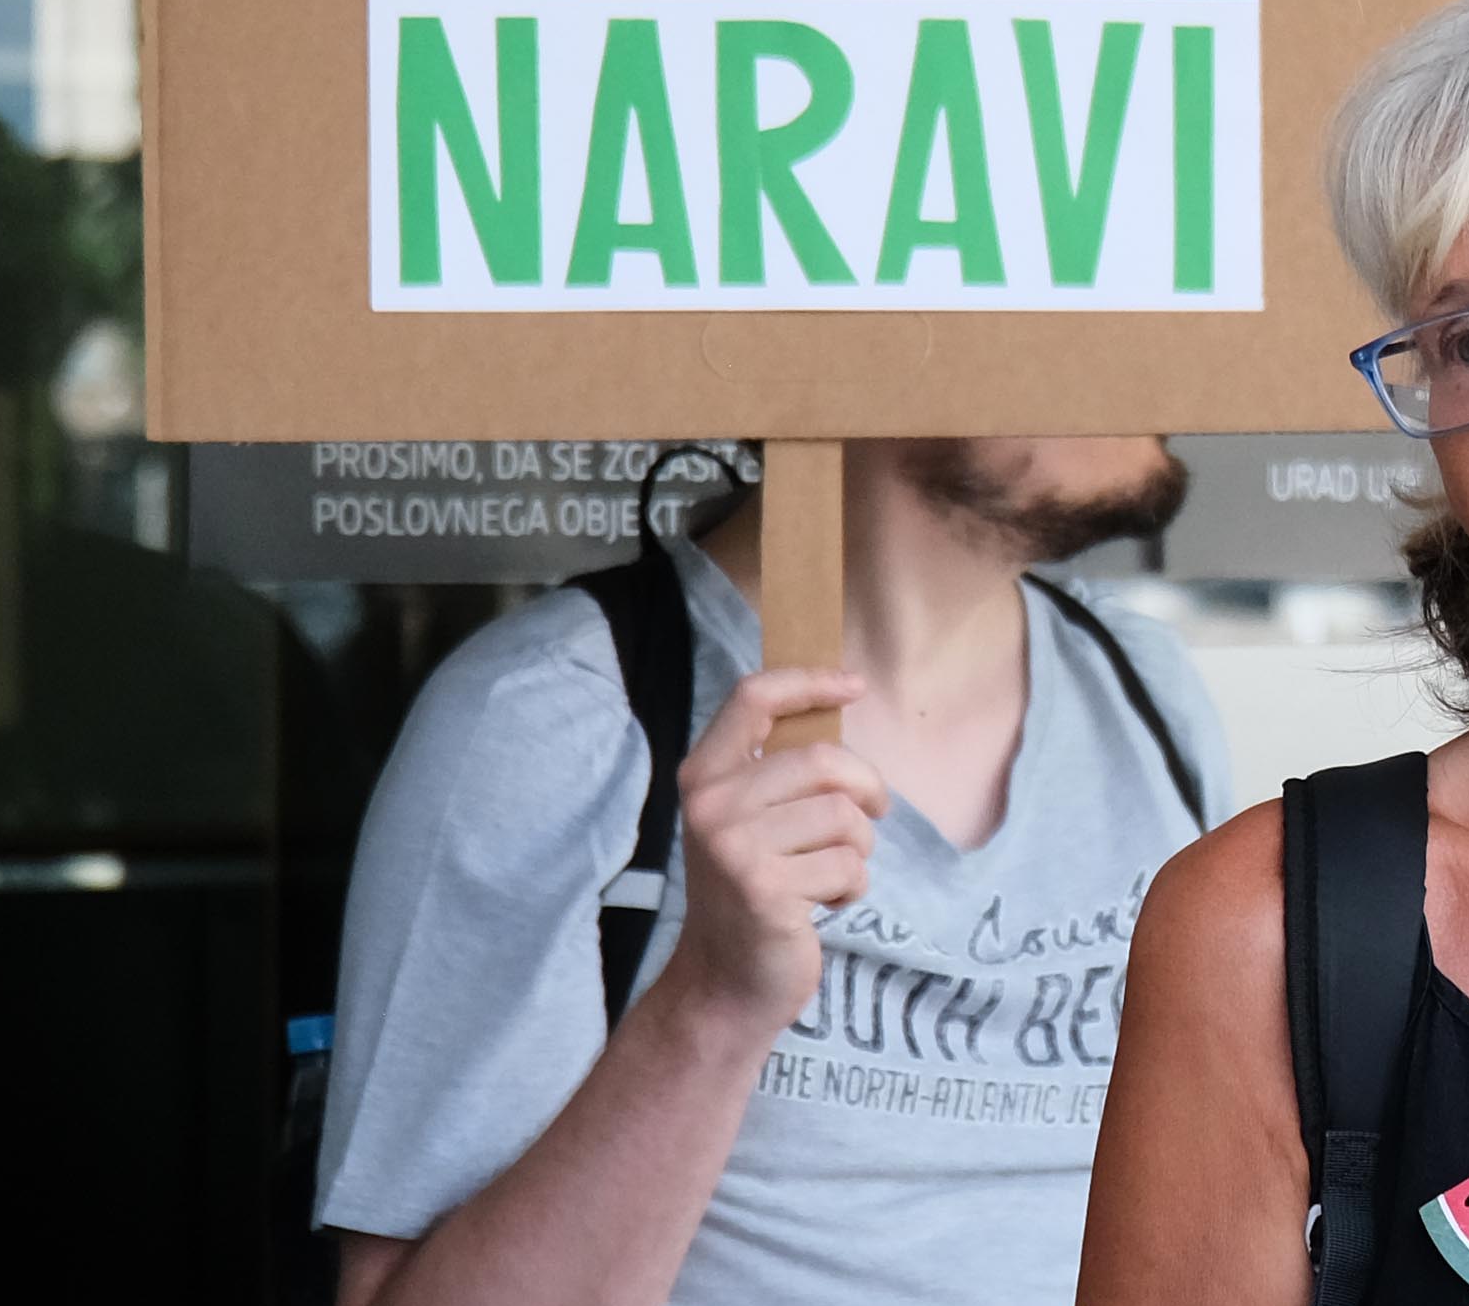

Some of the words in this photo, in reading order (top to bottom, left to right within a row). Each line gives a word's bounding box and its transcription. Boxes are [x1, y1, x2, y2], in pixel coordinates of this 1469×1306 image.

[397, 16, 1215, 294] NARAVI
[312, 441, 485, 486] PROSIMO,
[493, 442, 542, 482] DA
[547, 442, 595, 483] SE
[1268, 461, 1359, 503] URAD
[312, 497, 549, 538] POSLOVNEGA
[823, 1064, 1060, 1124] NORTH-ATLANTIC
